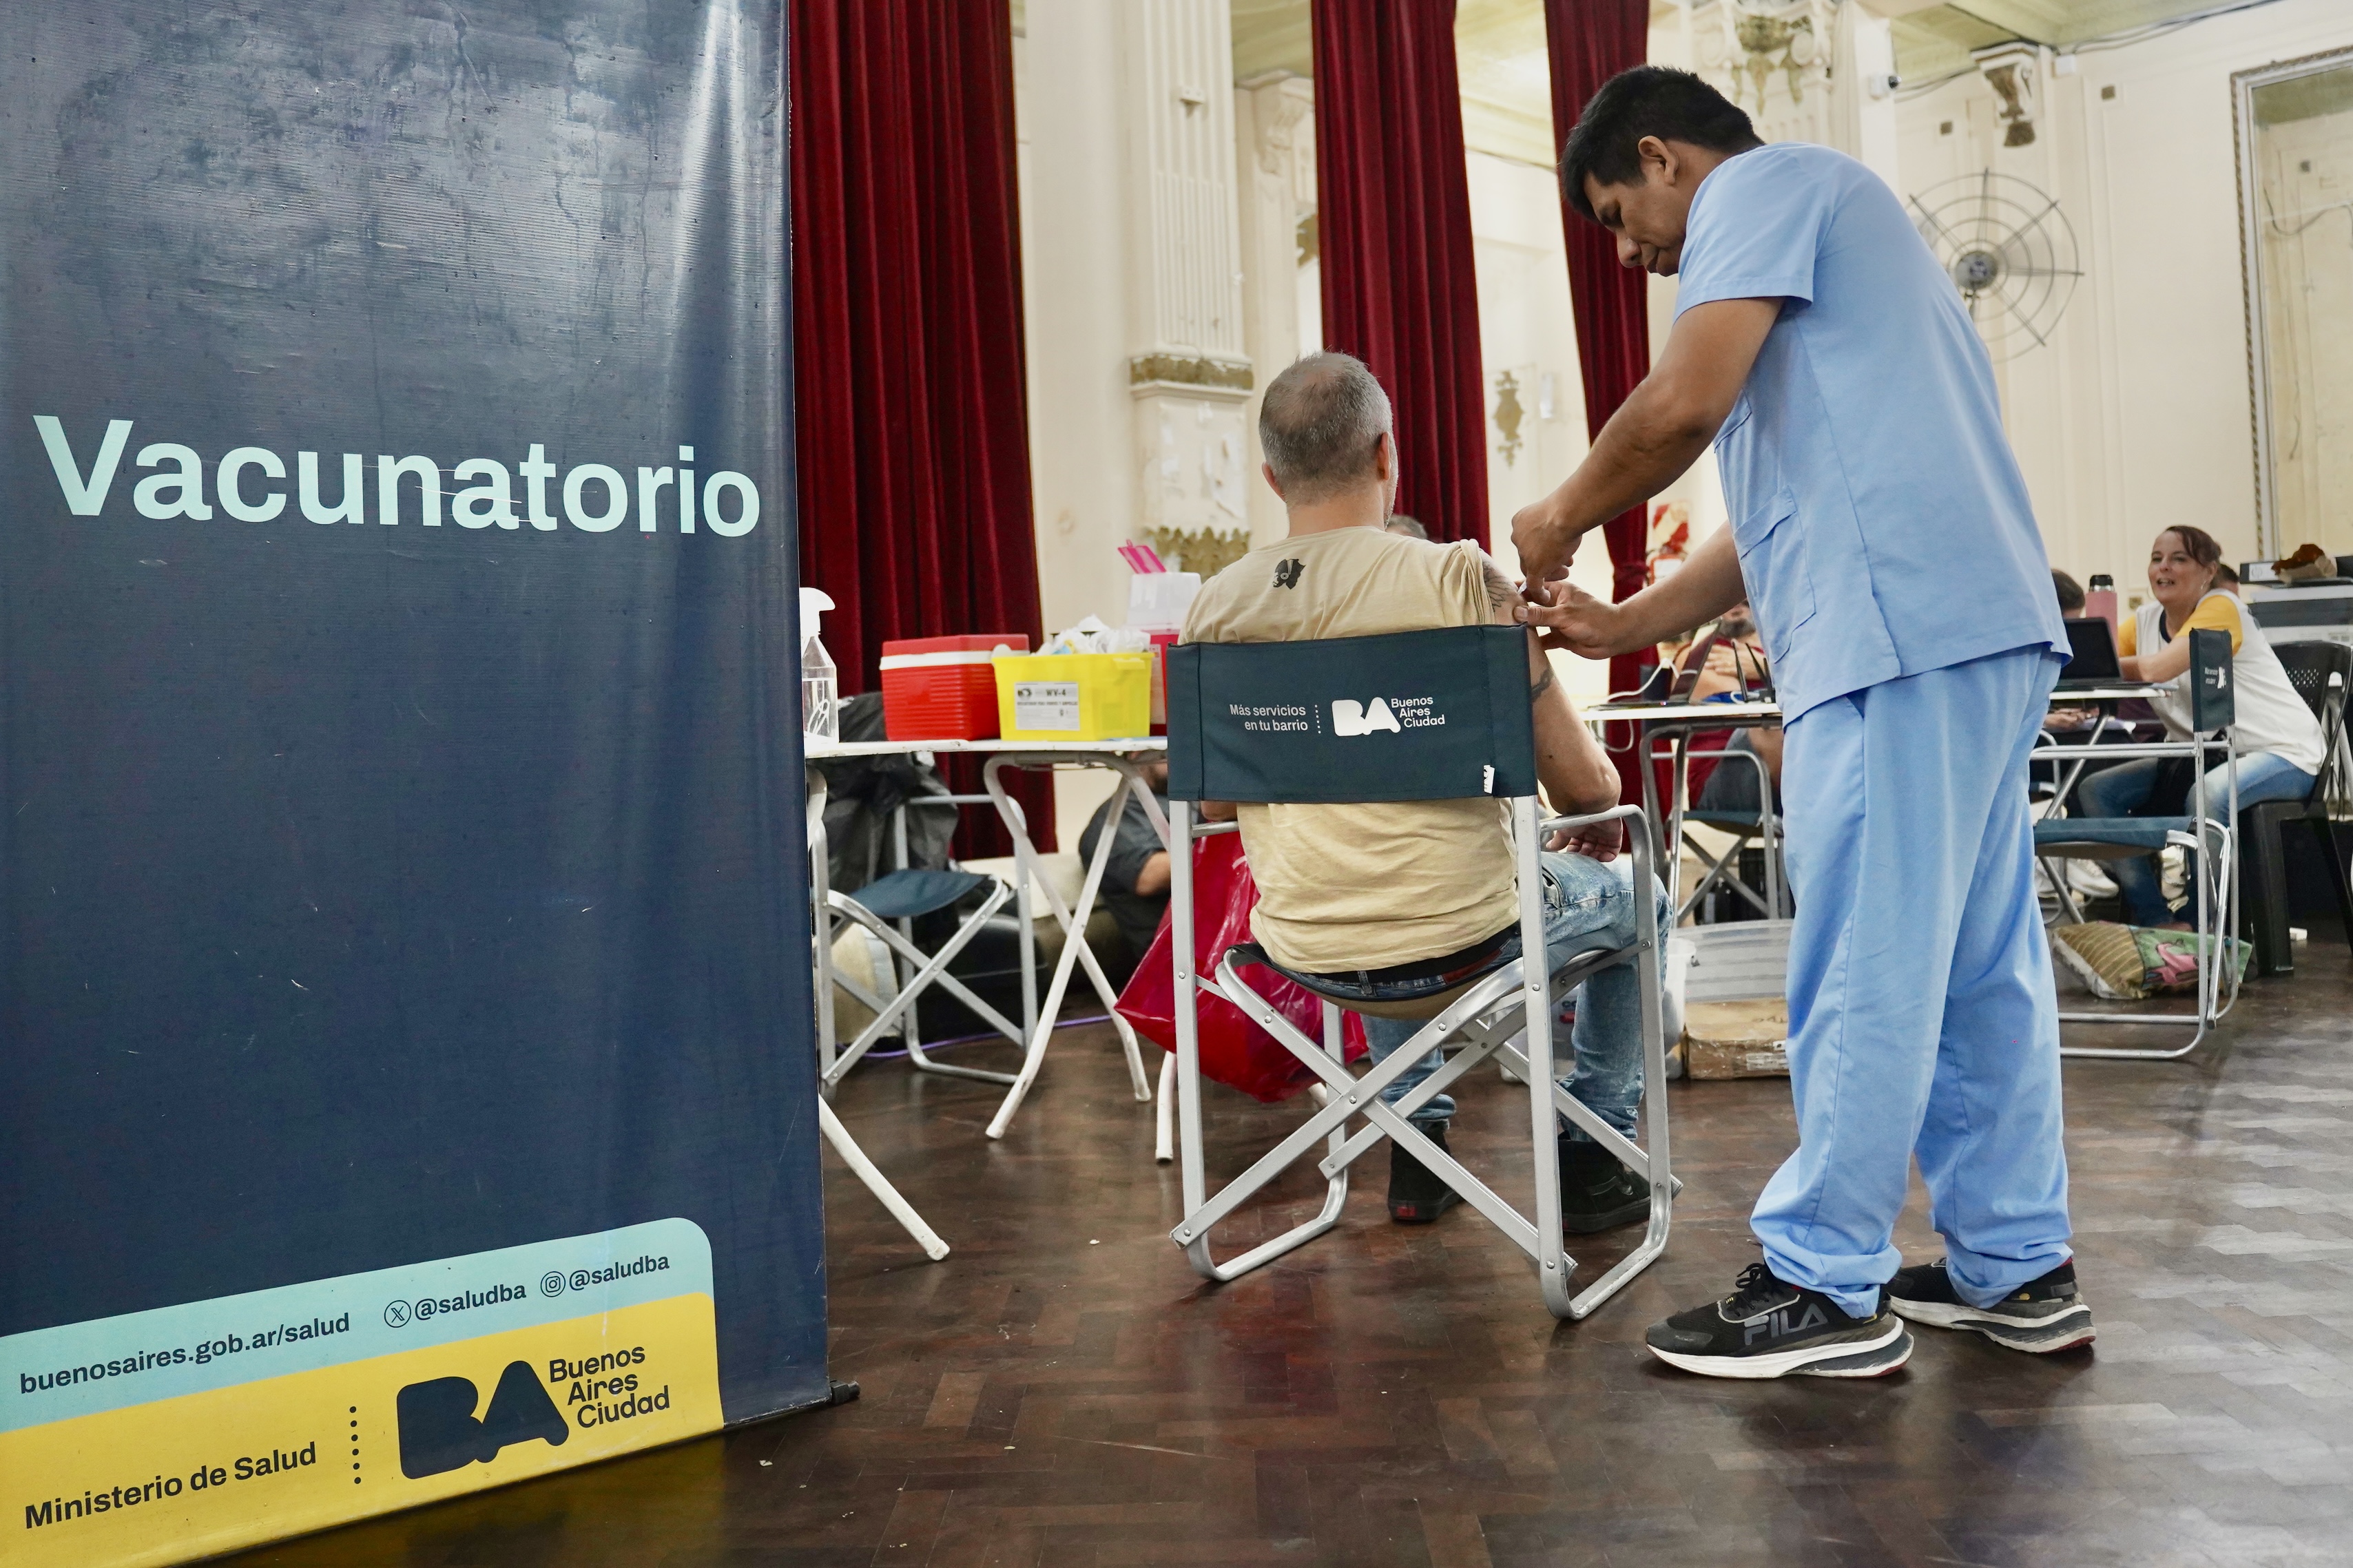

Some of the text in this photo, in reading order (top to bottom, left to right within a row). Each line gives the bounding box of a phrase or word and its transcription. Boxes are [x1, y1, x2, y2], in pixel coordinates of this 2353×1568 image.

[32, 415, 760, 537] Vacunatorio
[1230, 704, 1306, 716] Más servicios
[1331, 696, 1401, 737] BA
[1391, 697, 1434, 708] Buenos
[1399, 707, 1431, 718] Aires
[1403, 714, 1445, 728] Ciudad
[1244, 719, 1308, 731] en tu barrio
[569, 1255, 670, 1291] @saludba
[415, 1284, 527, 1321] @saludba
[1743, 1303, 1829, 1346] FILA
[20, 1312, 350, 1394] buenosaires.gob.ar/salud
[549, 1346, 645, 1383] Buenos
[567, 1374, 639, 1406] Aires
[577, 1384, 670, 1428] Ciudad
[396, 1360, 570, 1480] BA
[25, 1441, 316, 1529] Ministerio de Salud
